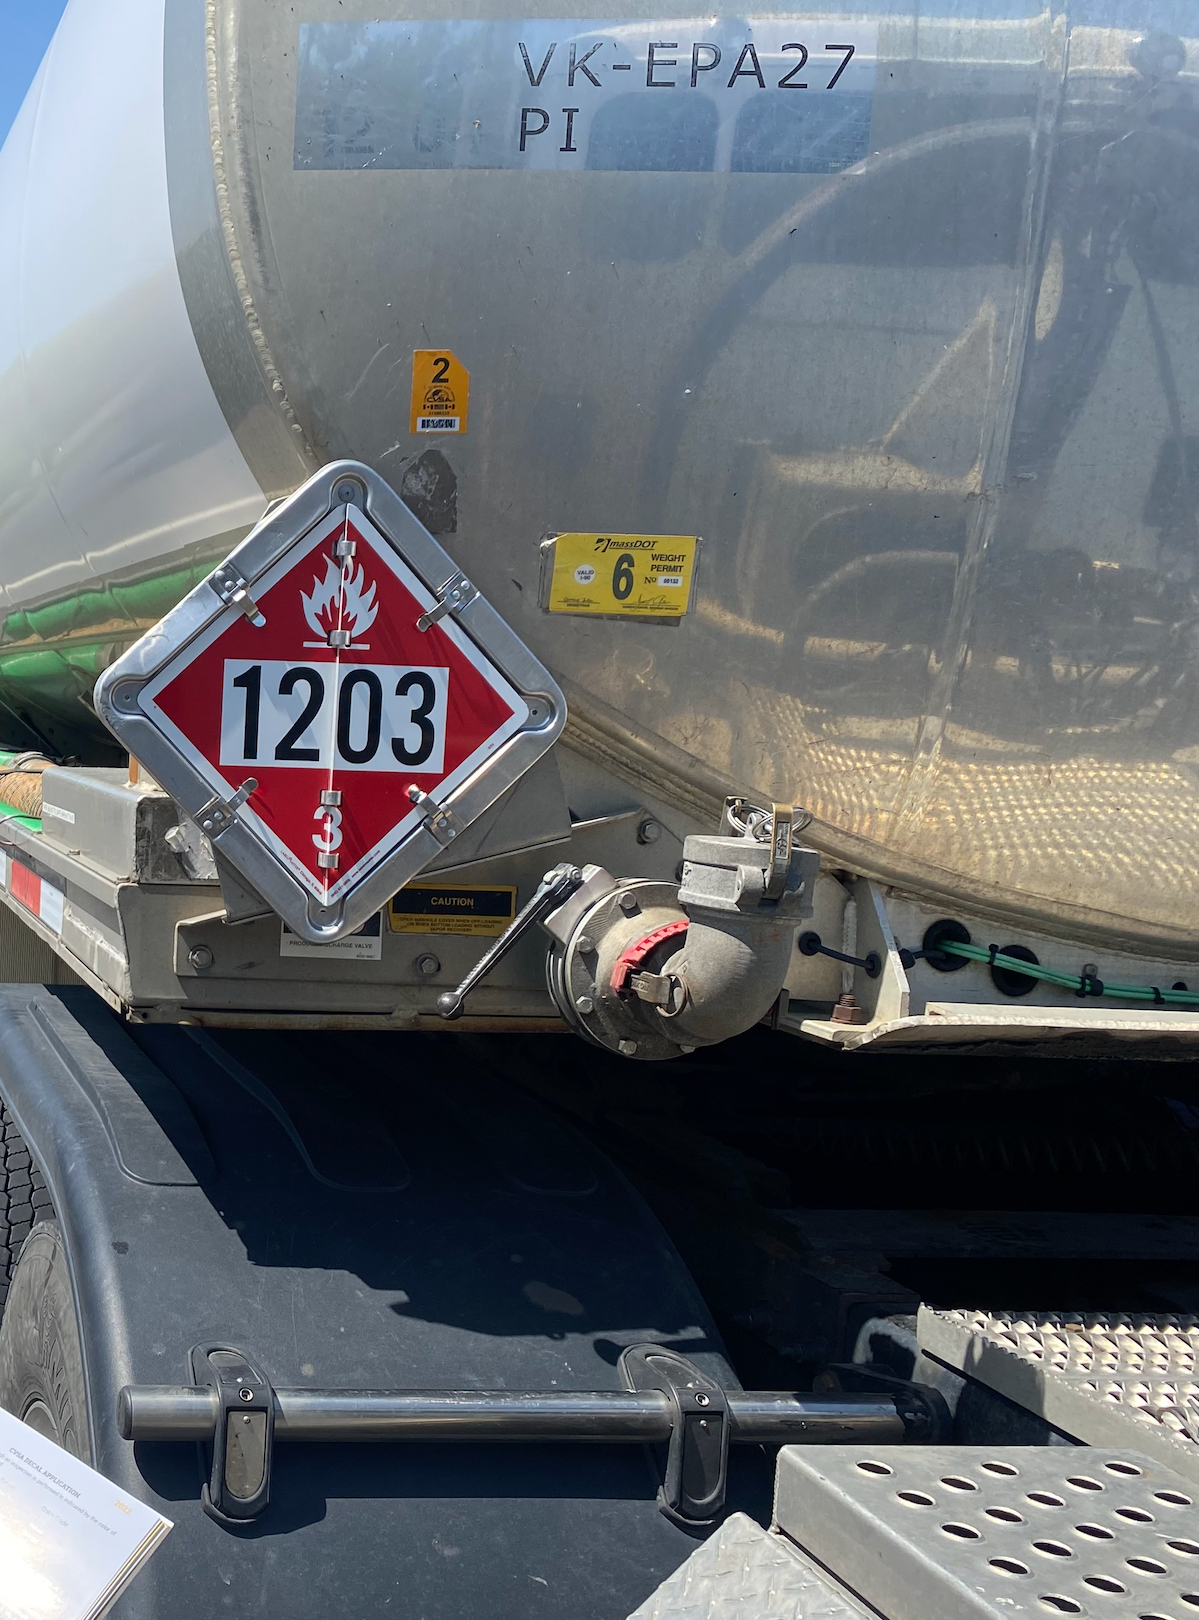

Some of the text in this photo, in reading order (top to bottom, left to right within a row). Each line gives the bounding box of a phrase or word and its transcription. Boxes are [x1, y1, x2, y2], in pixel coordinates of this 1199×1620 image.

[518, 42, 856, 89] VK-EPA27
[519, 107, 579, 152] PI
[431, 358, 449, 383] 2
[609, 540, 658, 549] massDOT
[651, 553, 686, 562] WEIGHT
[612, 553, 635, 600] 6
[650, 564, 684, 573] PERMIT
[231, 665, 436, 767] 1203
[311, 805, 343, 854] 3
[431, 897, 474, 907] CAUTION
[8, 1446, 81, 1499] CVSA DECAL APPLICATION
[112, 1498, 132, 1515] 2023
